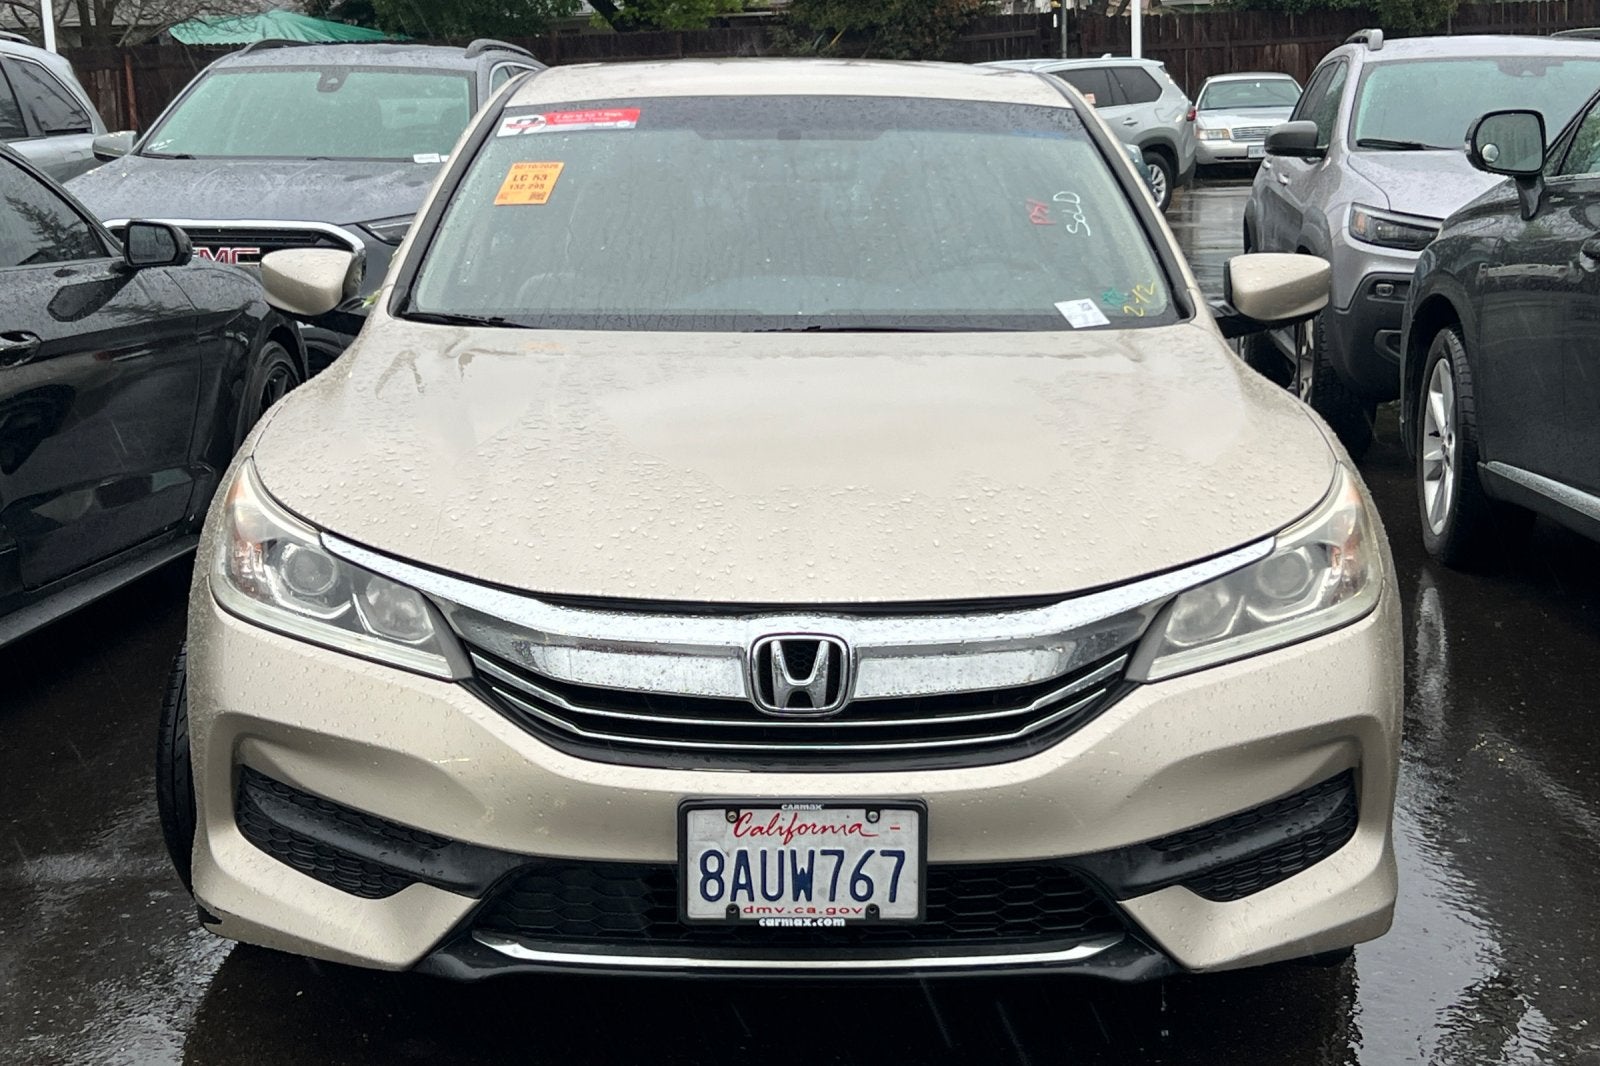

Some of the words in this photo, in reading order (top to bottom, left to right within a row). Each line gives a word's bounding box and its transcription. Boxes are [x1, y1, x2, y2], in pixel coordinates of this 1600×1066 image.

[192, 246, 261, 267] MC
[733, 812, 880, 845] California
[699, 849, 906, 904] 8AUW767
[743, 904, 863, 916] dmv.ca.gov
[758, 916, 846, 928] carmax.com
